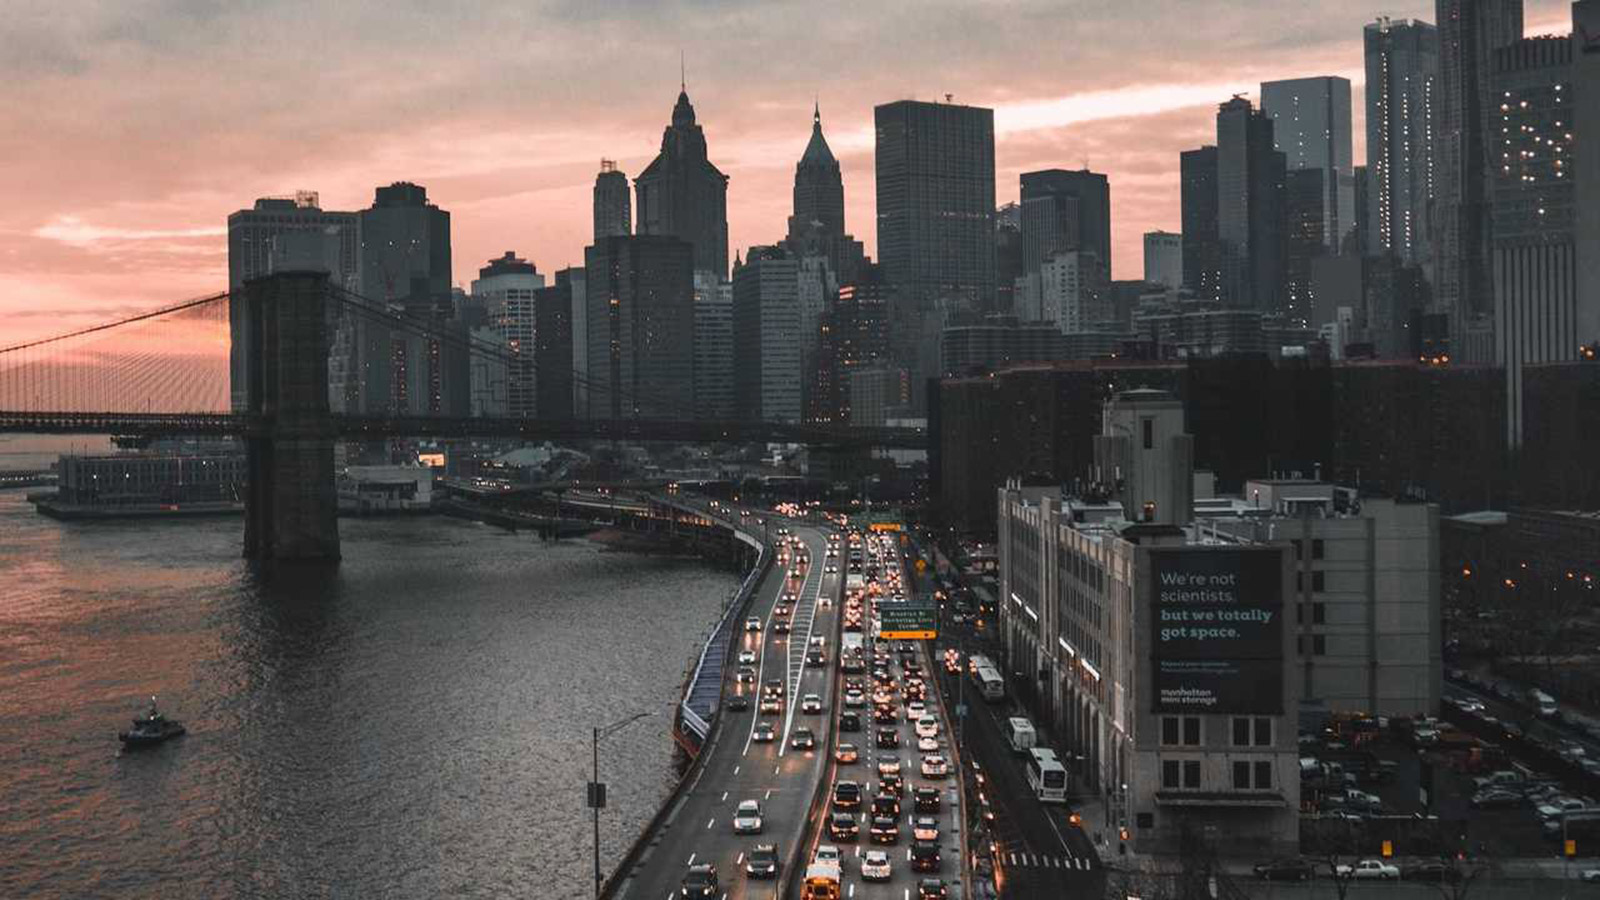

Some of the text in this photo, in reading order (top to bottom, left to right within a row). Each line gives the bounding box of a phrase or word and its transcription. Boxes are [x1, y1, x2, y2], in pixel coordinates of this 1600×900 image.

[1161, 572, 1236, 585] We're not
[1161, 609, 1272, 624] but we totally
[1161, 627, 1240, 641] got space.
[1161, 687, 1211, 696] manhattan
